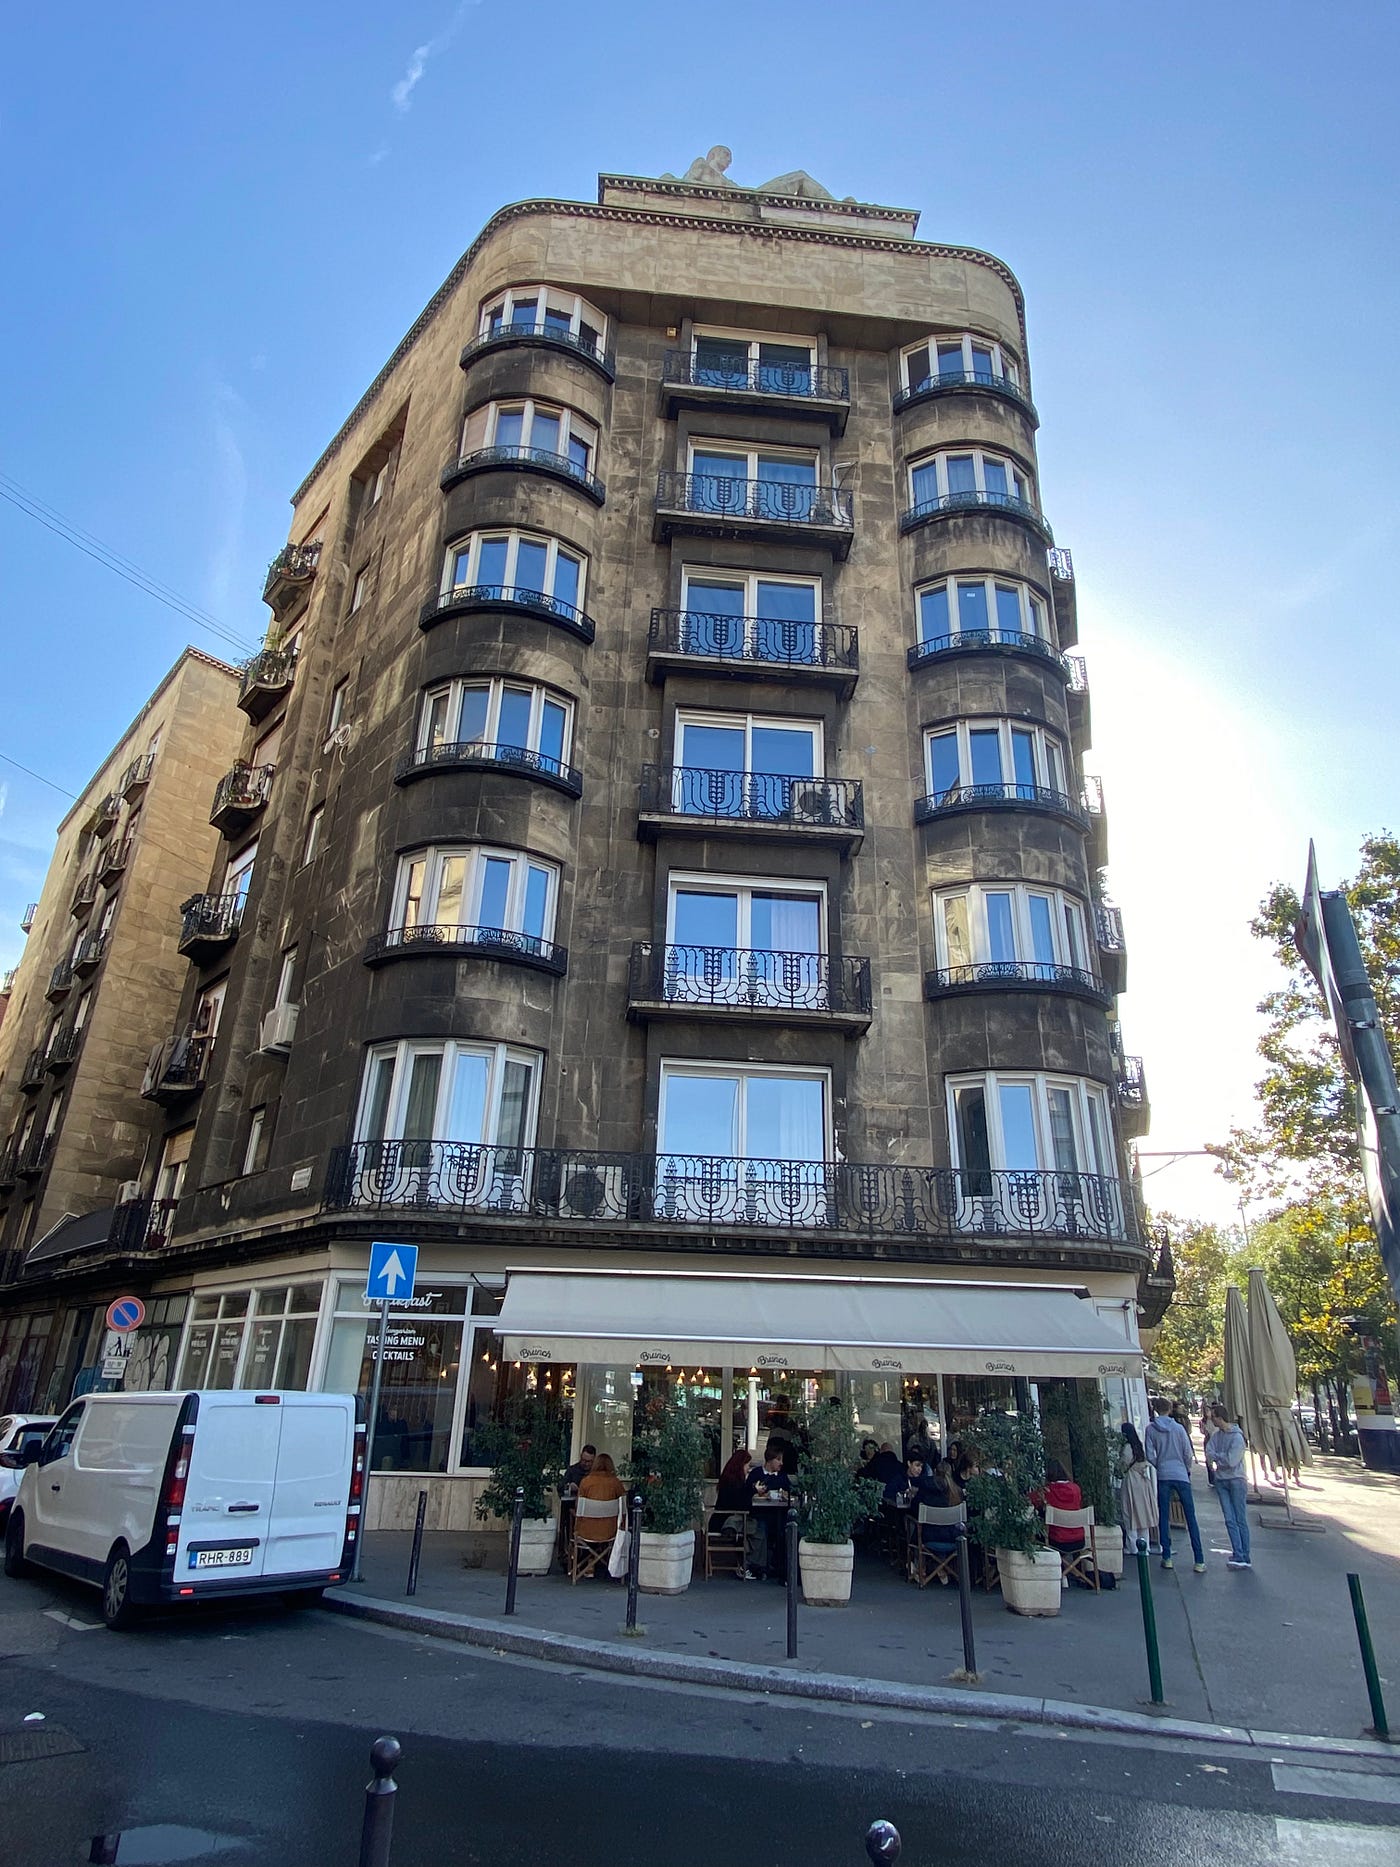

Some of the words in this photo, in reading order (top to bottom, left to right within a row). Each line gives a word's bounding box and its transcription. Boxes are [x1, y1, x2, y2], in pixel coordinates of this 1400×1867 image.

[367, 1335, 398, 1346] TASING
[400, 1336, 425, 1346] MENU
[372, 1351, 414, 1361] CCKTAILS
[519, 1348, 552, 1360] Brunch
[640, 1351, 671, 1362] Brunch
[757, 1355, 788, 1366] Brunch
[872, 1358, 902, 1369] Brunch
[199, 1550, 249, 1565] RHR-889
